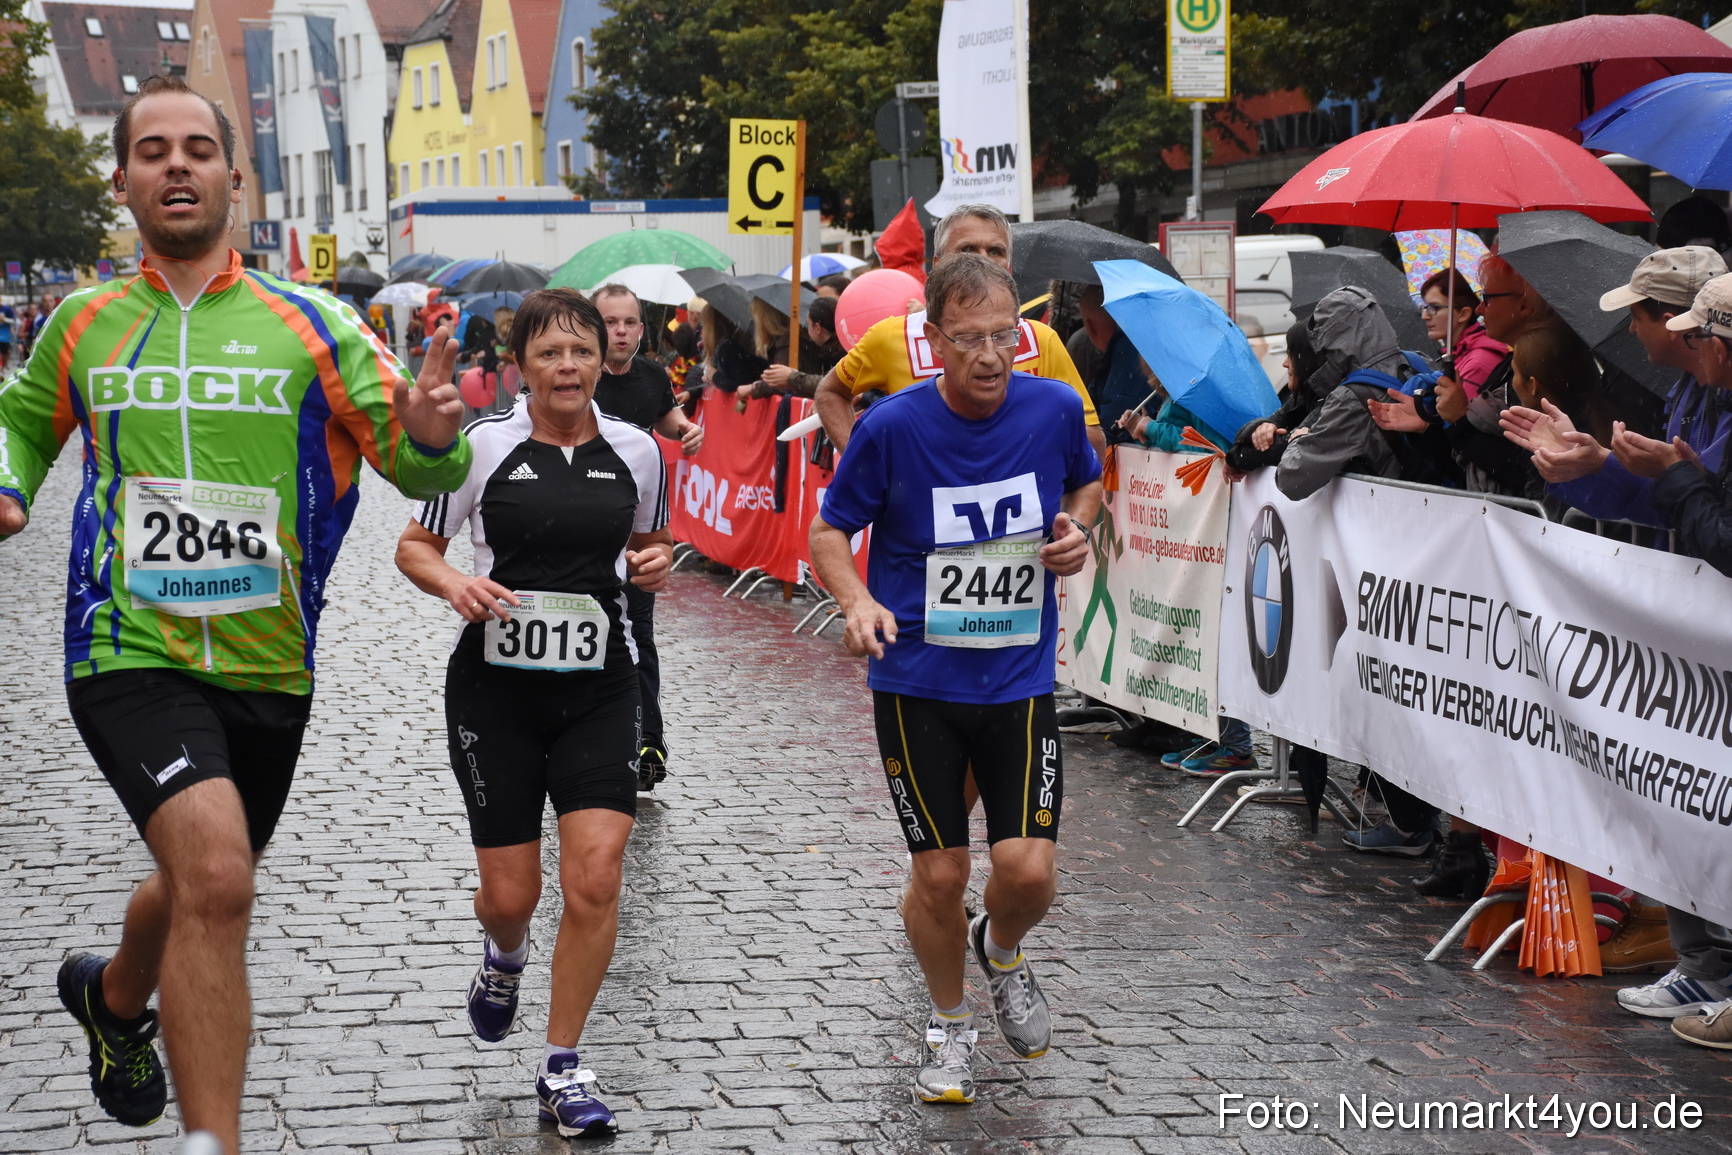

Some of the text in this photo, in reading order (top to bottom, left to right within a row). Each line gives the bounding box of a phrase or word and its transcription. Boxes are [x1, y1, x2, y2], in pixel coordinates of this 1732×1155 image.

[1179, 37, 1217, 46] Marktplatz
[739, 124, 796, 146] Block
[747, 154, 785, 211] C
[316, 248, 330, 269] D
[88, 366, 293, 415] BOCK
[508, 472, 538, 480] adidas
[586, 469, 616, 480] Johanna
[191, 486, 268, 509] BOCK
[142, 511, 268, 563] 2846
[982, 542, 1037, 555] BOCK
[1248, 509, 1290, 574] BMW
[131, 559, 138, 568] C
[157, 576, 252, 597] Johannes
[940, 564, 1035, 606] 2442
[543, 596, 600, 612] BOCK
[931, 601, 936, 609] C
[1357, 571, 1425, 646] BMW
[958, 617, 1012, 633] Johann
[497, 617, 598, 662] 3013
[1356, 651, 1428, 712] WENIGER
[1431, 674, 1561, 754] VERBRAUCH.
[1559, 715, 1606, 778] MEHR
[466, 752, 487, 807] odlo
[1039, 737, 1057, 809] SKINS
[890, 777, 926, 842] SKINS
